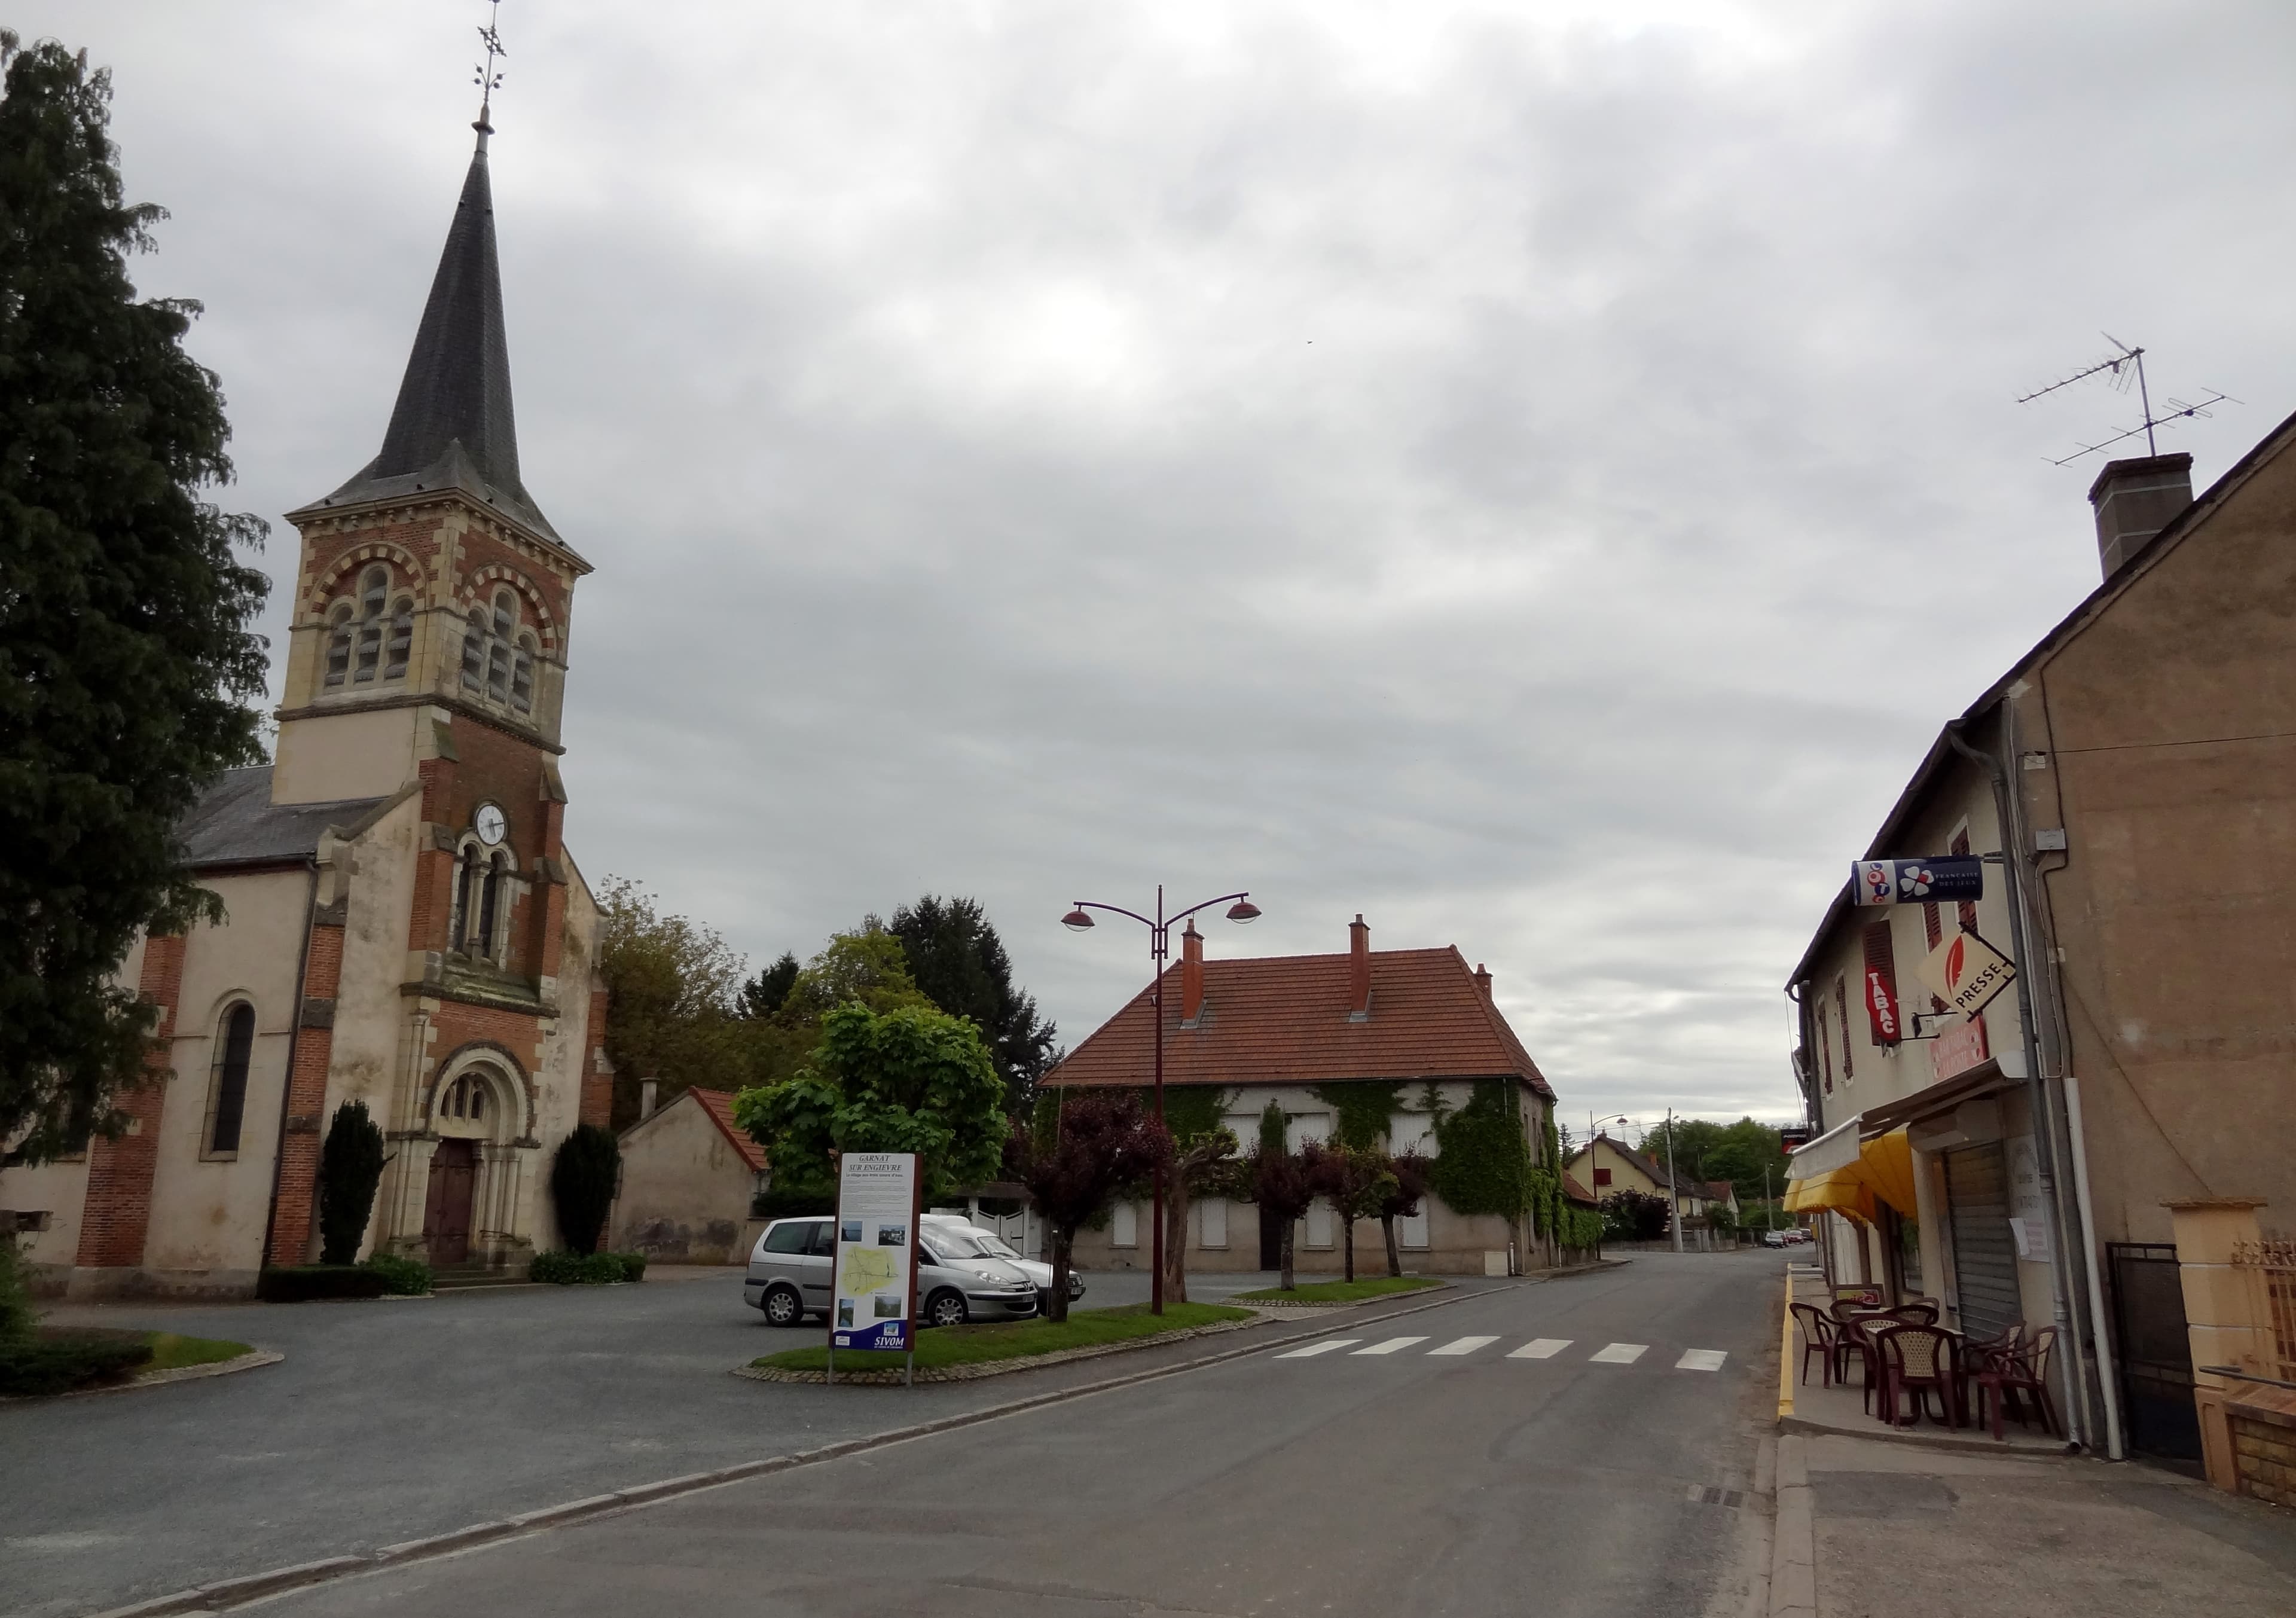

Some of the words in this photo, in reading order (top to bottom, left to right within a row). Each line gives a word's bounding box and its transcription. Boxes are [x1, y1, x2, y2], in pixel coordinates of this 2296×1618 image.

[1868, 972, 1894, 1034] TABAC
[1955, 963, 2001, 1008] PRESSE
[874, 1336, 904, 1346] SIVOM
